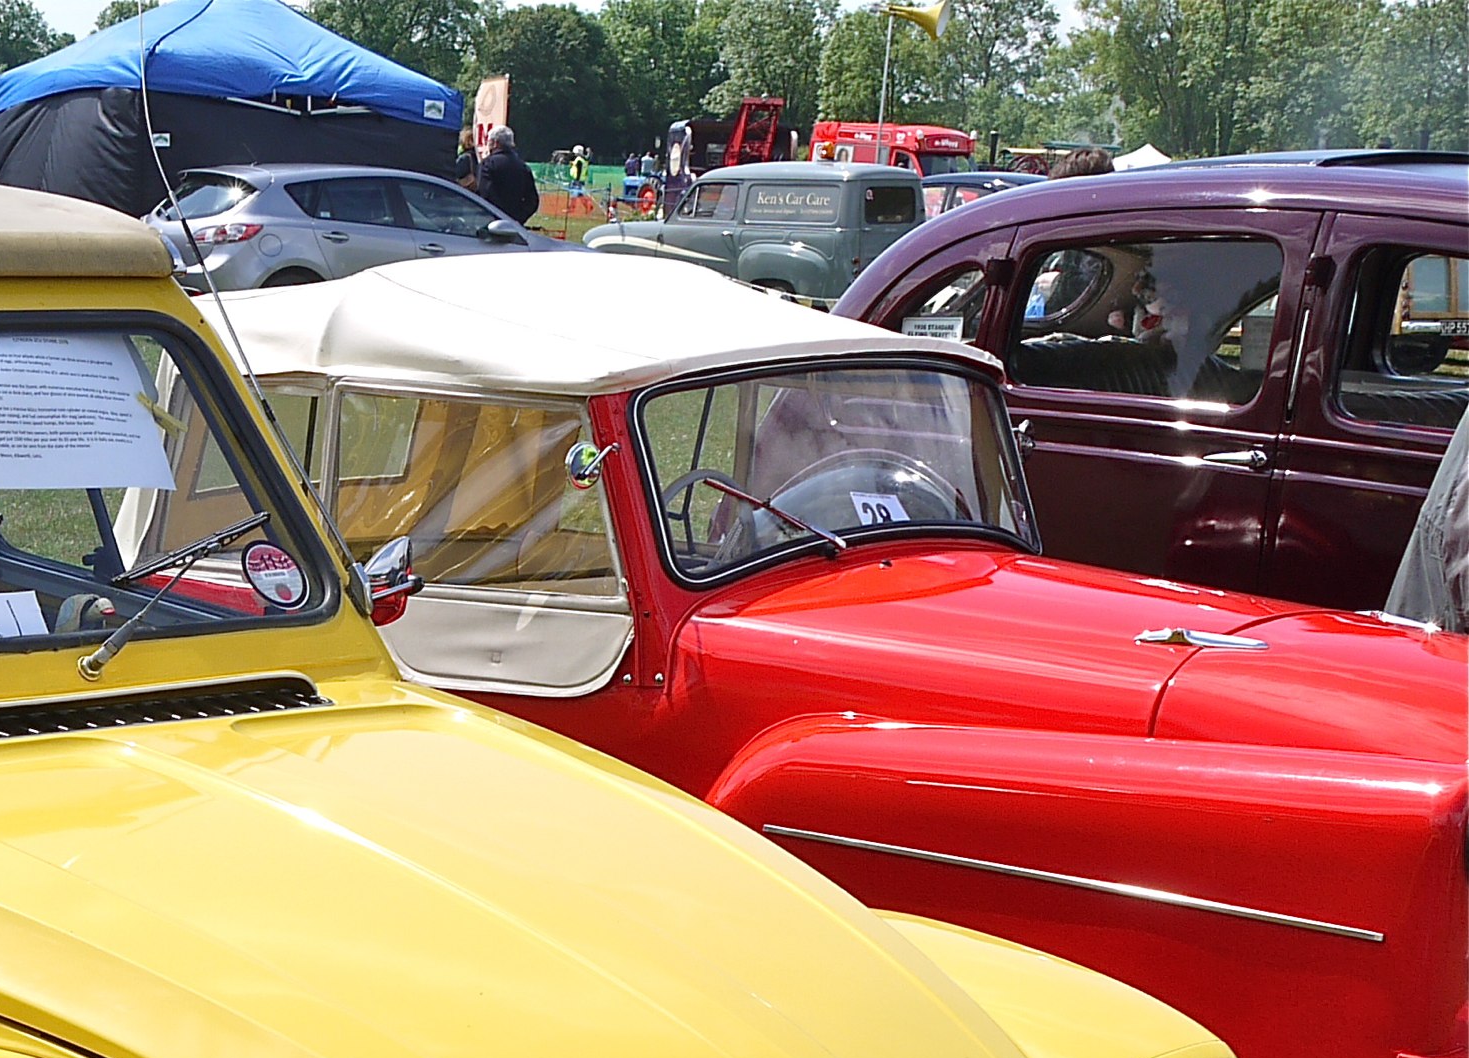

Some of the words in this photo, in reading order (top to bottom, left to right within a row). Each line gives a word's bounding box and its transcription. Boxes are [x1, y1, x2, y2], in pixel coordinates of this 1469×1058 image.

[757, 191, 783, 205] Ken's
[785, 192, 805, 206] Car
[806, 193, 831, 206] Care
